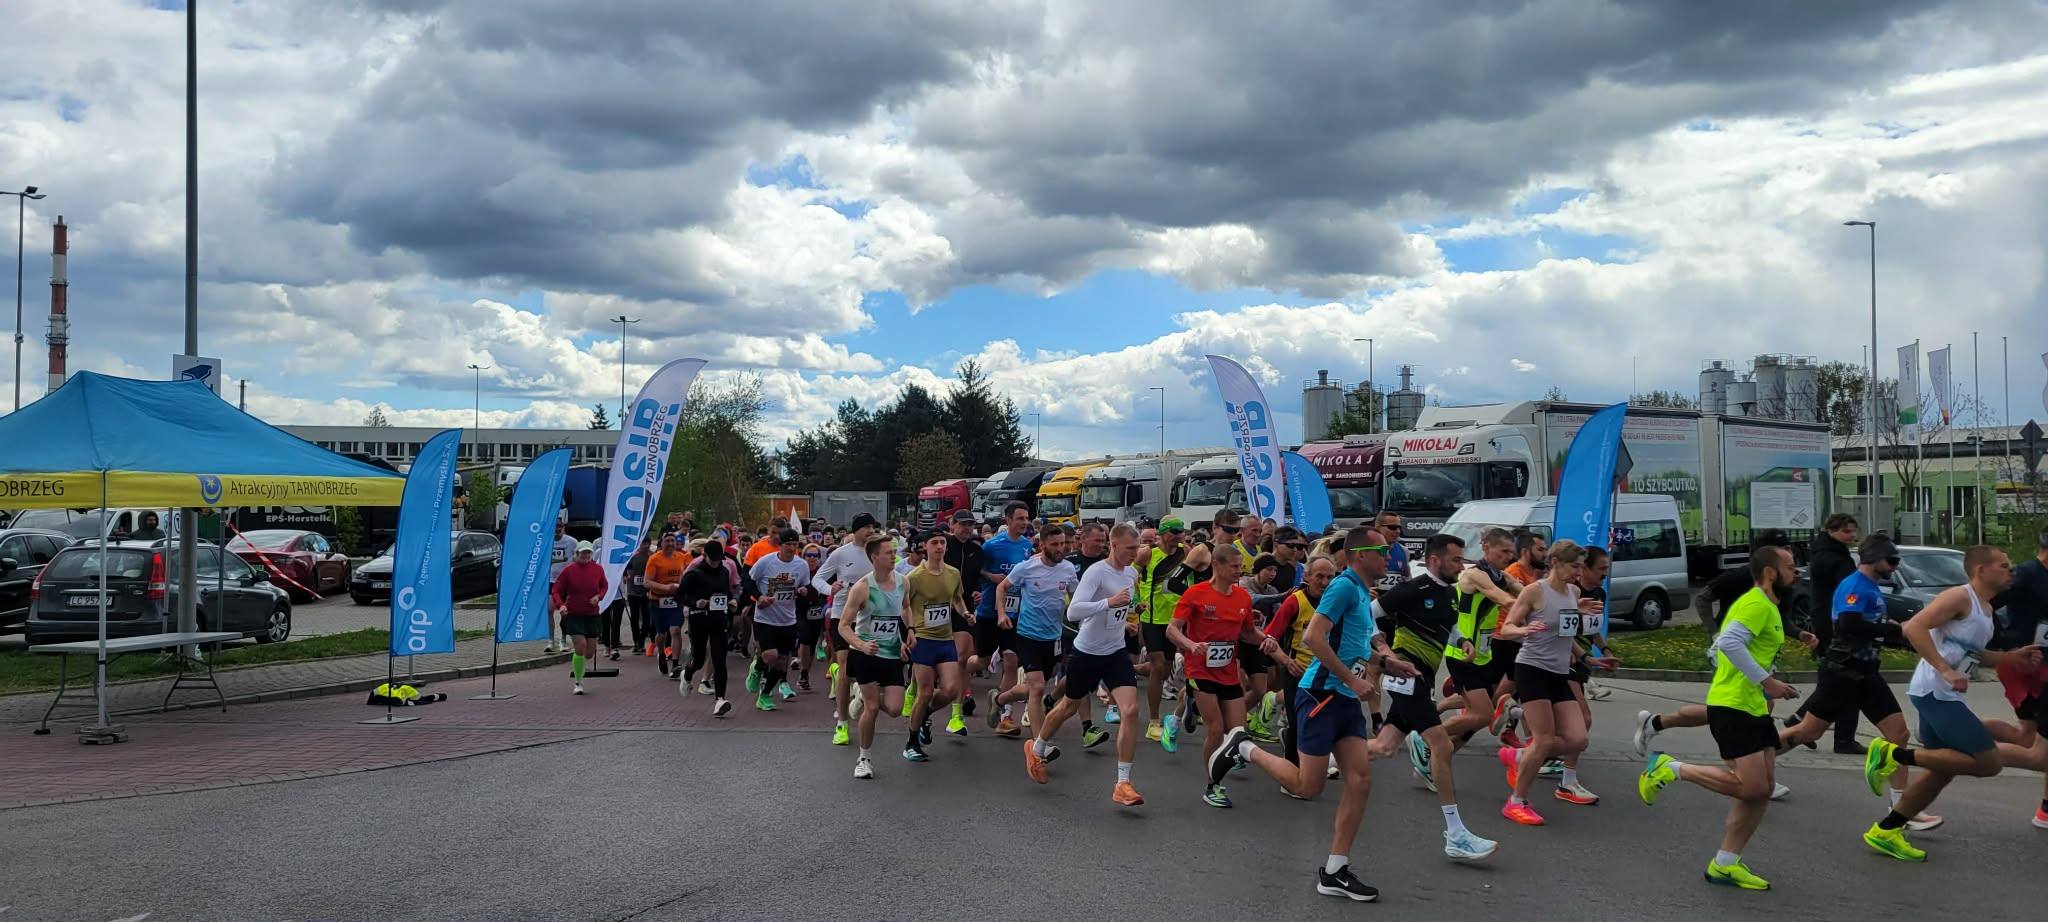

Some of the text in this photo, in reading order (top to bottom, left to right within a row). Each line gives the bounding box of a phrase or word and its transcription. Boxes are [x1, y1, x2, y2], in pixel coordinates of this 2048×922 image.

[646, 405, 668, 486] TARNOBRZEG
[1403, 437, 1459, 452] MIKOŁAJ
[1313, 454, 1374, 466] MIKOŁAJ
[230, 480, 358, 499] Atrakcyjny TARNOBRZEG
[1633, 478, 1698, 493] TO SZYBCIUTKO,
[714, 597, 726, 606] 93
[778, 592, 793, 600] 172
[928, 608, 947, 621] 179
[1114, 608, 1128, 621] 97
[874, 622, 896, 633] 142
[1563, 616, 1579, 629] 39
[408, 609, 433, 652] arp
[1209, 647, 1235, 661] 220
